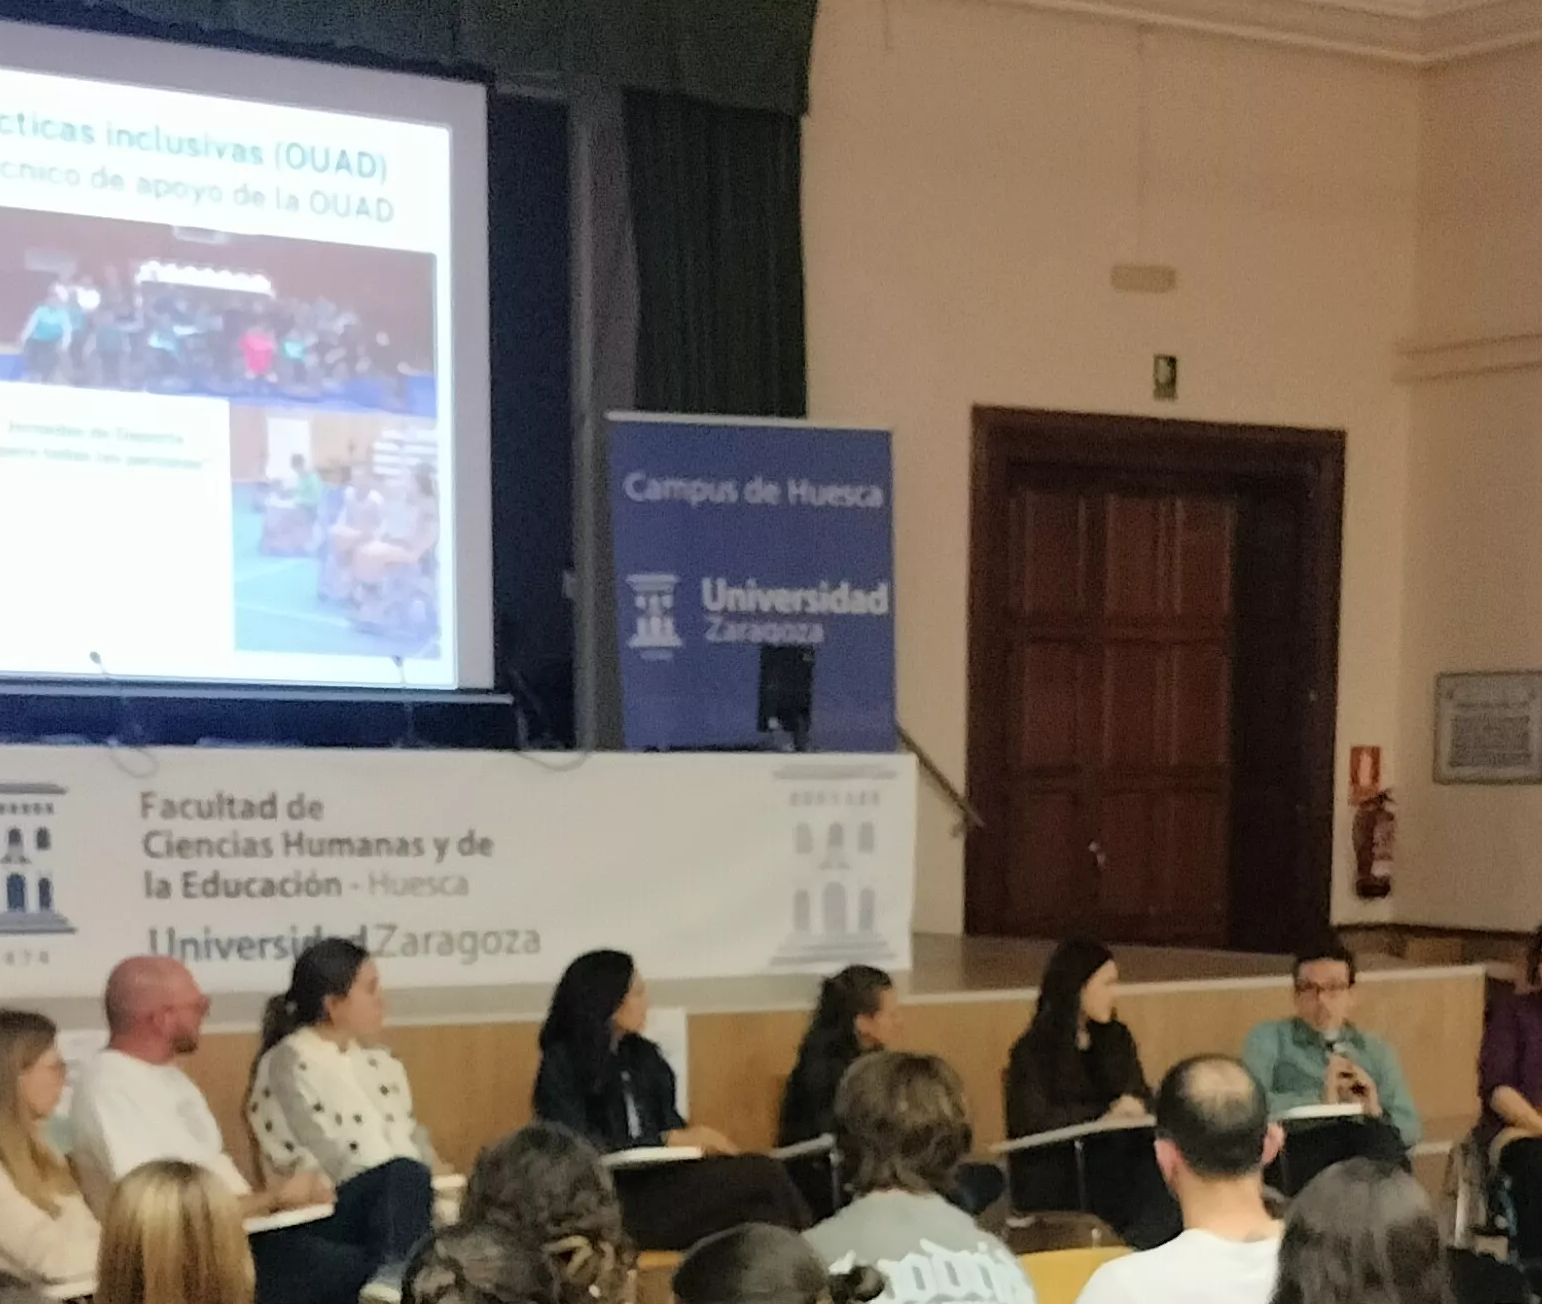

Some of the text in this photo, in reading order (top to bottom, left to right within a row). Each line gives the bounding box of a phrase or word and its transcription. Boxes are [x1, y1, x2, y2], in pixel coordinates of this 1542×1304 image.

[106, 121, 264, 165] inclusivas
[274, 141, 388, 185] (OUAD)
[90, 165, 125, 192] de
[136, 174, 223, 207] apoyo
[233, 183, 266, 208] de
[275, 185, 300, 212] la
[309, 189, 395, 223] OUAD
[622, 471, 884, 508] Campus de Huesca
[701, 576, 889, 617] Universidad
[702, 613, 825, 646] Zaragoza
[139, 790, 326, 821] Facultad de
[141, 828, 496, 864] Ciencias Humanas y de
[143, 869, 173, 900] la
[180, 869, 344, 899] Educación
[367, 870, 471, 898] Huesca
[373, 922, 542, 965] Zaragoza
